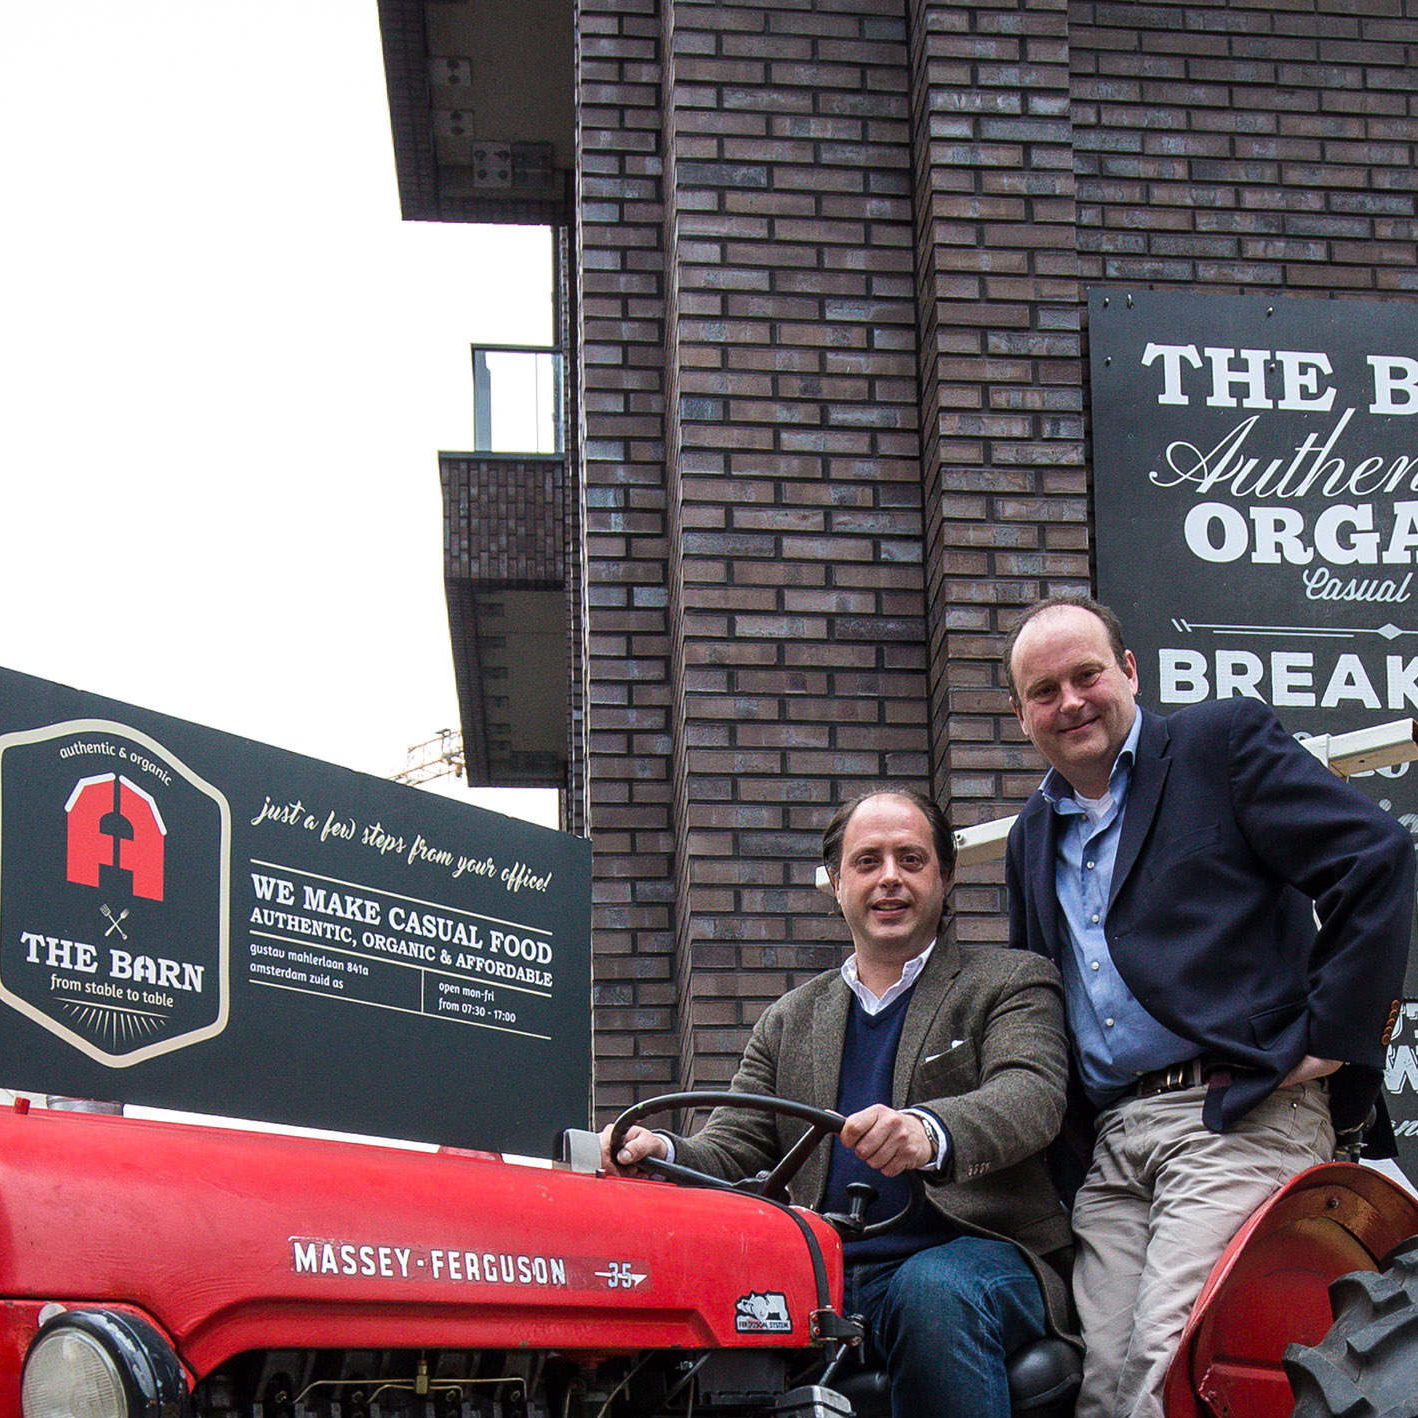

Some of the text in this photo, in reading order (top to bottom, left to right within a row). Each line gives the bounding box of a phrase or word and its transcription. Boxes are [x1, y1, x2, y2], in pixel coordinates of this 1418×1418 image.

[1141, 342, 1338, 412] THE
[1302, 567, 1414, 603] Casual
[59, 740, 173, 787] authentic & organic
[250, 796, 553, 893] just a few steps from your office!
[250, 873, 553, 965] WE MAKE CASUAL FOOD
[20, 931, 205, 993] THE BARN
[250, 907, 553, 988] AUTHENTIC, ORGANIC & AFFORDABLE
[287, 948, 345, 971] mahlerlaan
[346, 961, 369, 977] 841a
[49, 973, 174, 1008] from stable to table
[249, 962, 344, 990] amsterdam zuid as
[438, 982, 495, 1003] open mon-fri
[438, 998, 460, 1013] from
[462, 1002, 486, 1018] 07:30
[493, 1008, 516, 1024] 17:00
[607, 1261, 634, 1288] 35
